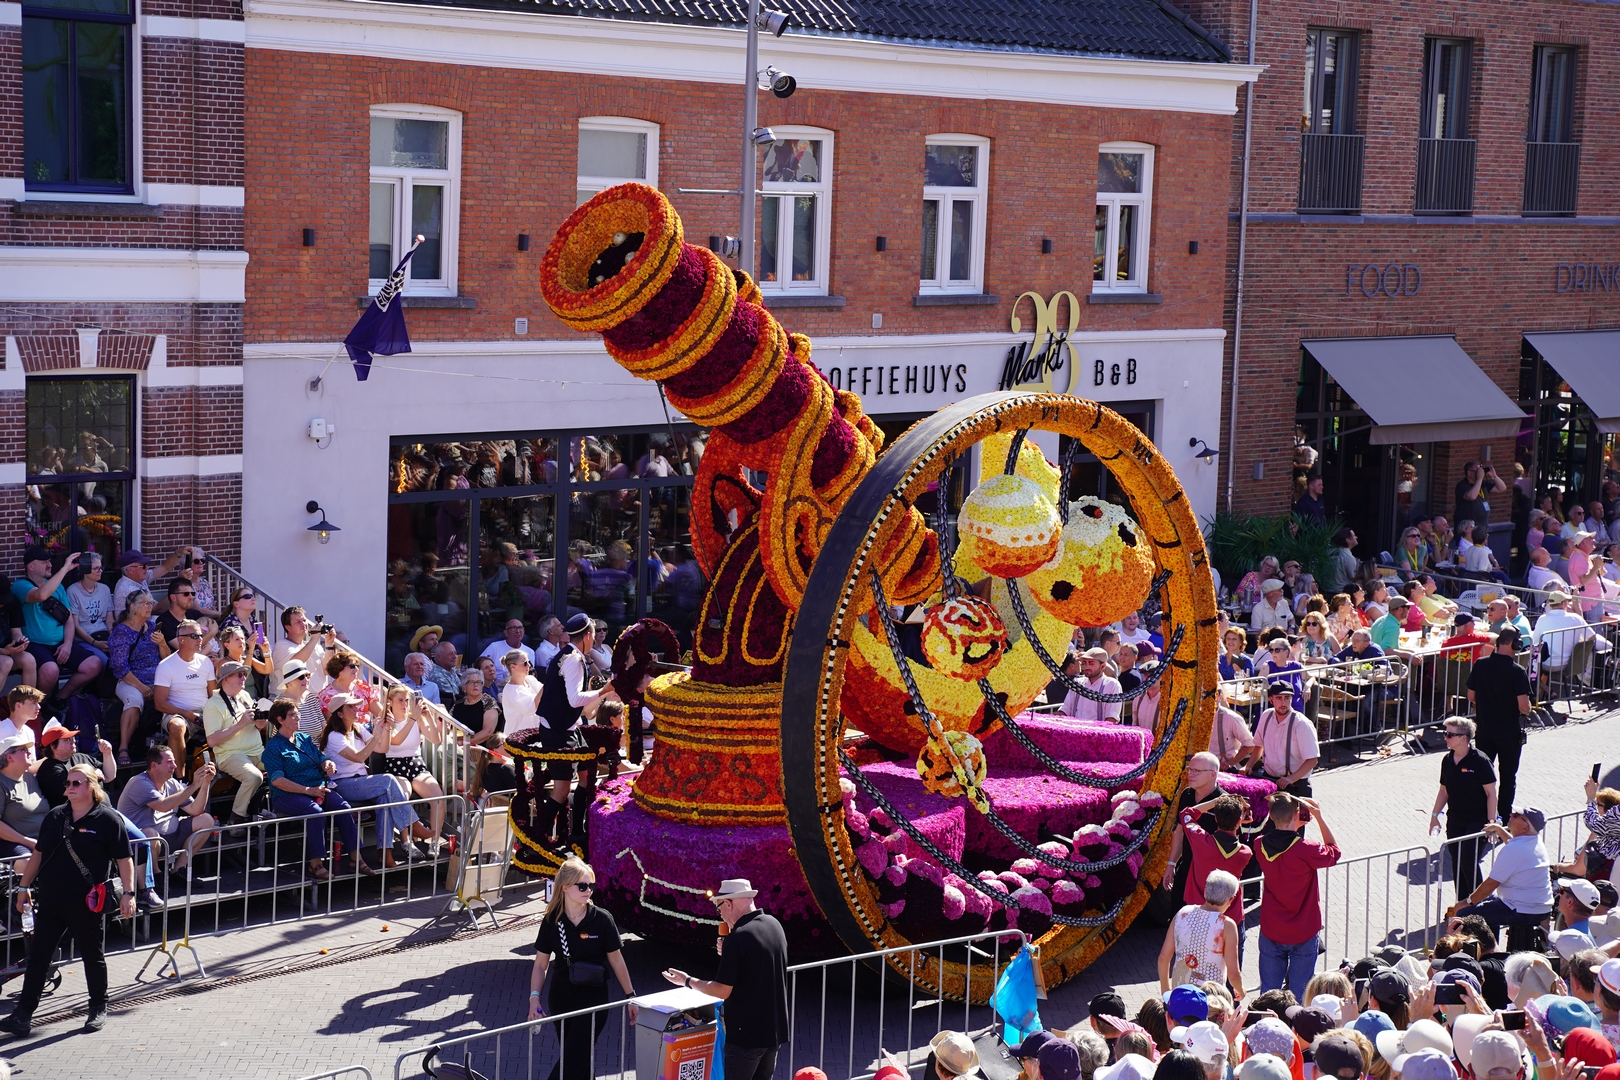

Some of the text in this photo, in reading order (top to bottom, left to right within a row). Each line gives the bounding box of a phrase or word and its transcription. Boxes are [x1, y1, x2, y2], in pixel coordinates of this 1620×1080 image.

[1347, 263, 1422, 298] FOOD
[819, 362, 968, 396] OFFIEHUYS
[27, 520, 63, 531] VINCENT
